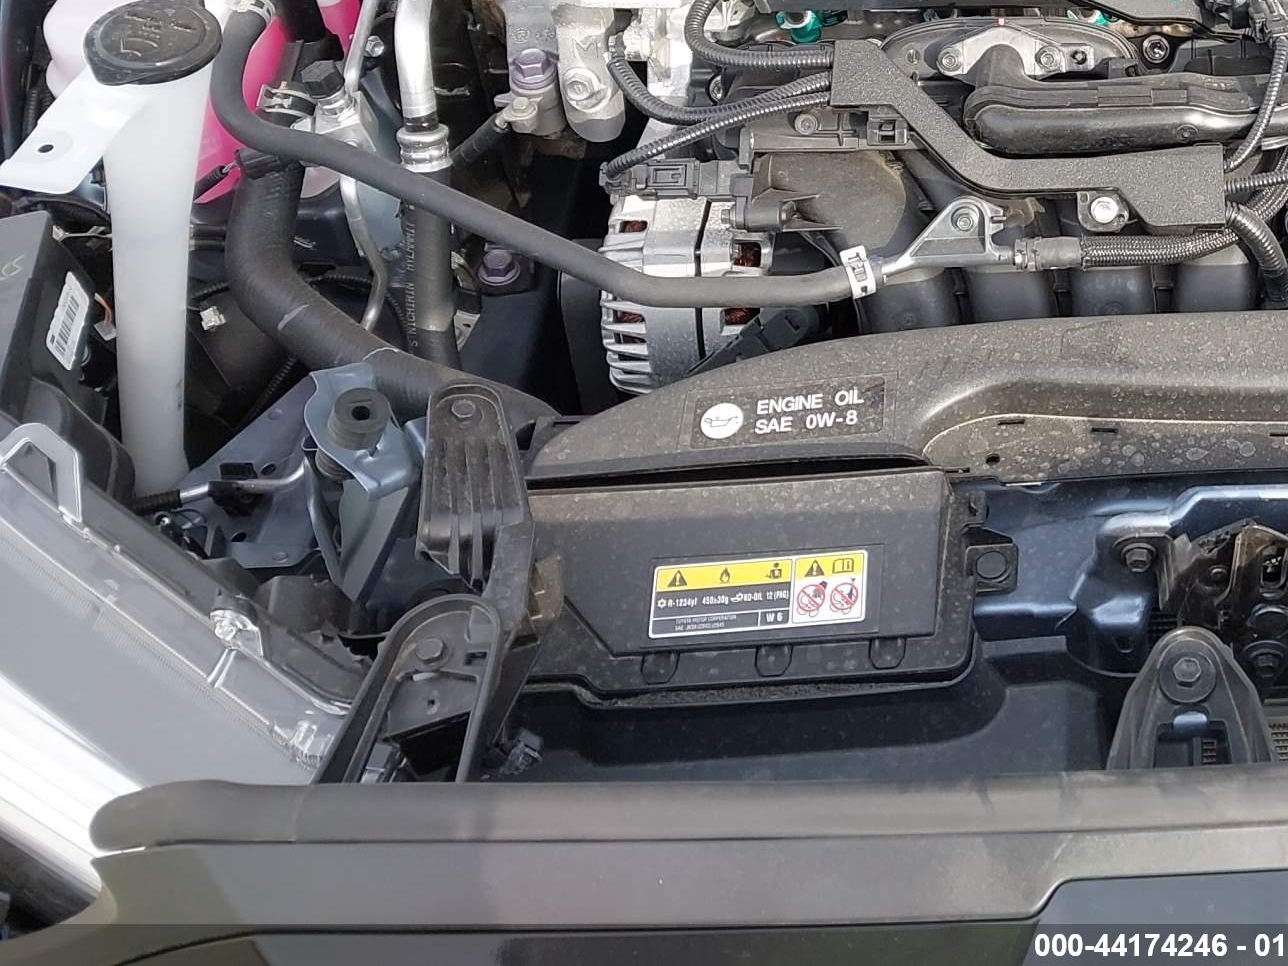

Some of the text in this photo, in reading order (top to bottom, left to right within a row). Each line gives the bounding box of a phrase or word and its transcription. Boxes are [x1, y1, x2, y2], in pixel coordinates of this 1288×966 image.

[756, 386, 865, 415] ENGINE OIL
[755, 409, 858, 435] SAE 0W-8
[766, 612, 777, 623] W
